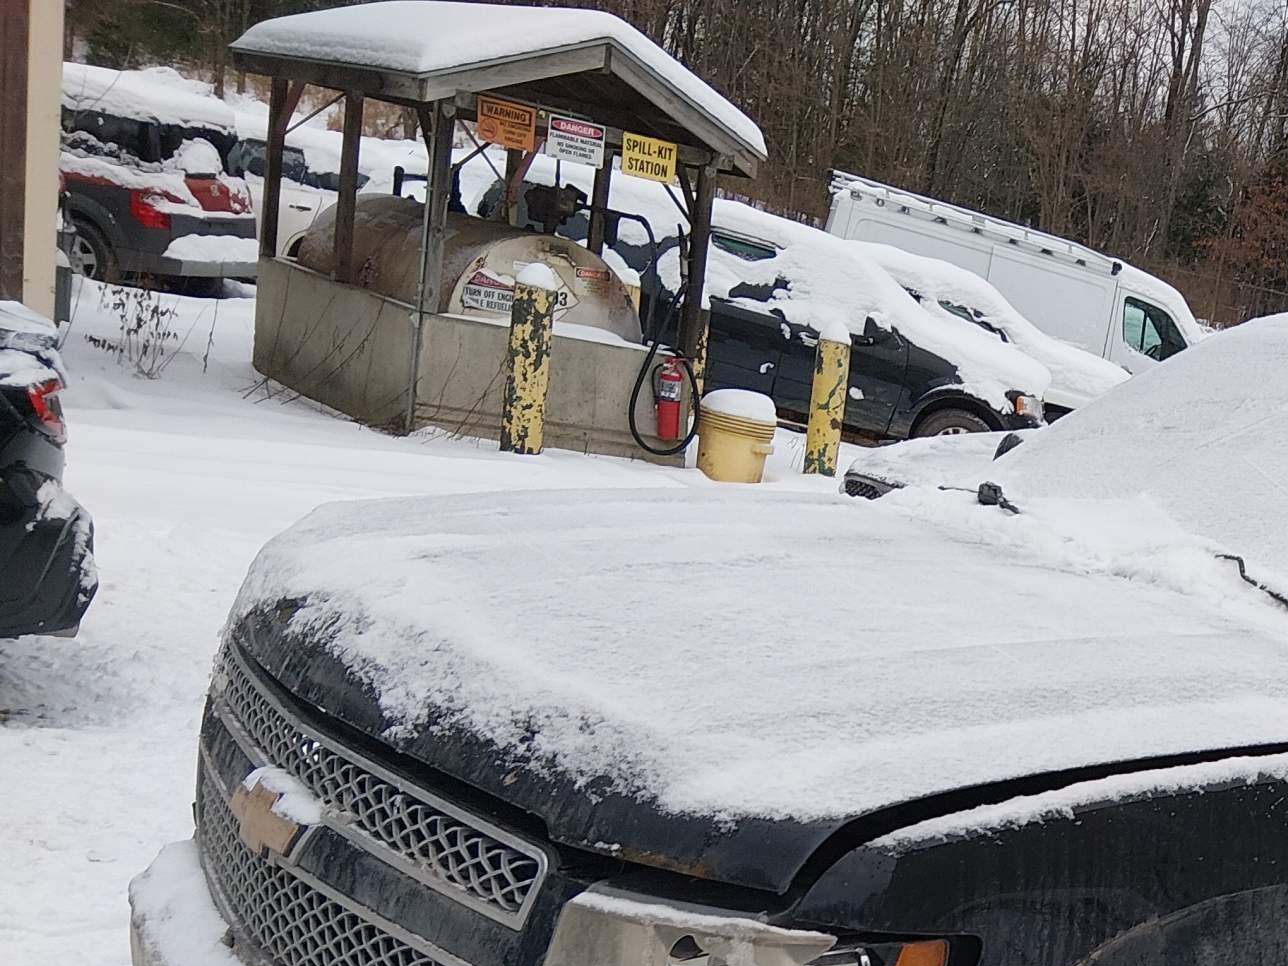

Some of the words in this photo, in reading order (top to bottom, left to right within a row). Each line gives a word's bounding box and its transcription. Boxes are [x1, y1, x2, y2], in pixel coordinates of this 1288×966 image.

[486, 104, 526, 122] WARNING
[560, 121, 594, 136] DANGER
[626, 138, 673, 160] SPILL-KIT
[628, 157, 668, 178] STATION
[464, 287, 481, 297] TURN
[484, 290, 495, 299] OFF
